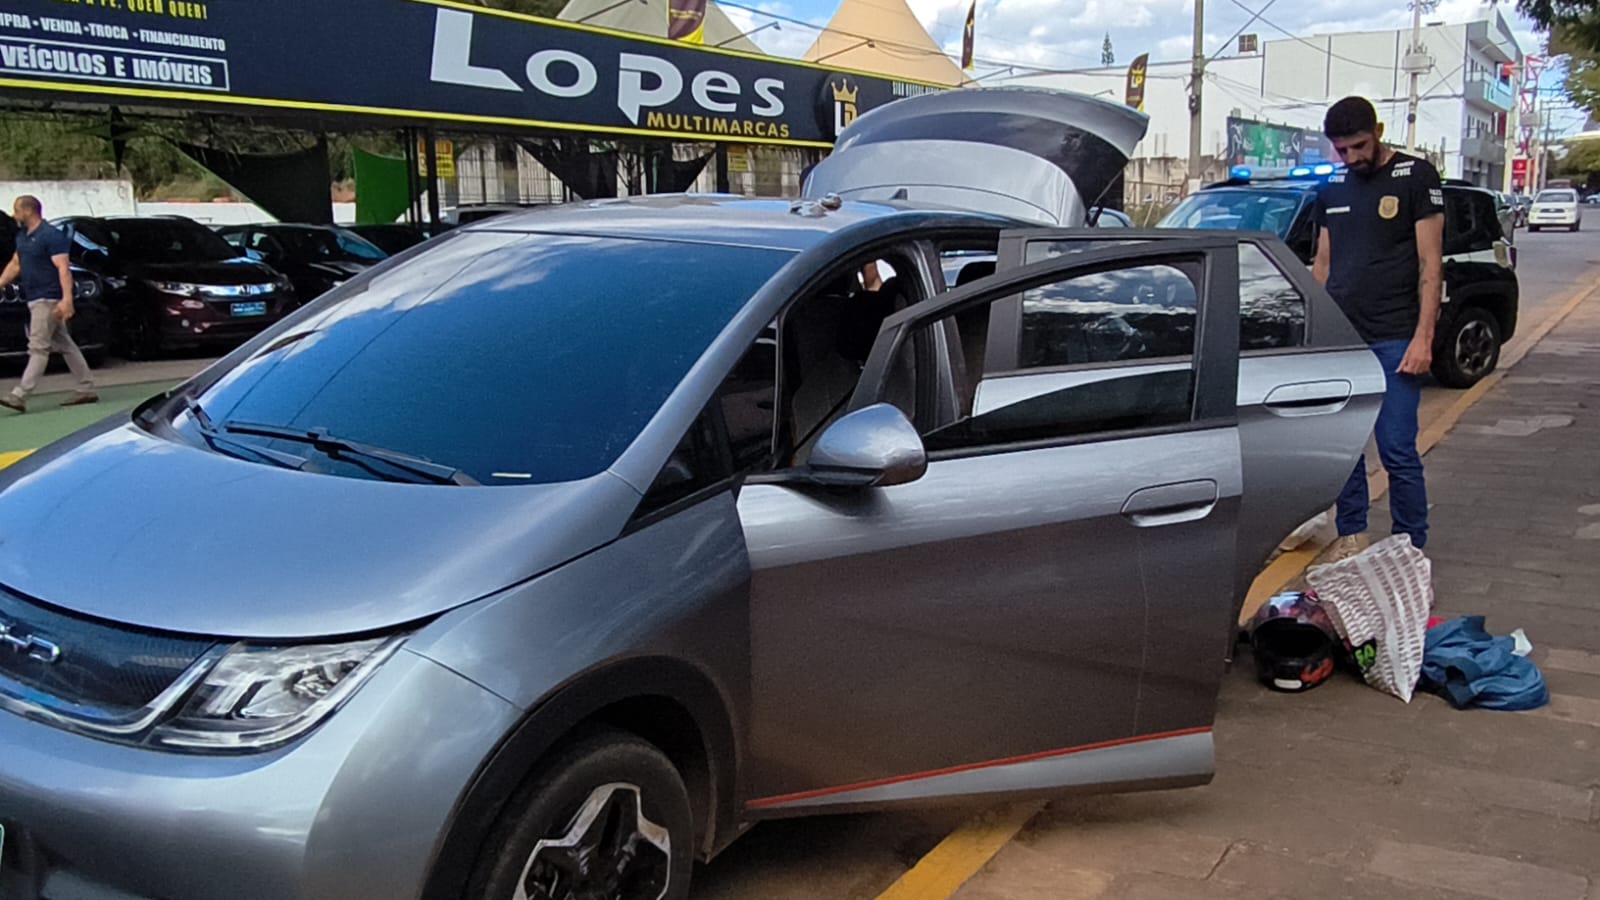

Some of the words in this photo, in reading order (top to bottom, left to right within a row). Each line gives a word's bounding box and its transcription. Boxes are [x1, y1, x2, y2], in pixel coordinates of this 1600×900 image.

[169, 1, 208, 20] QUER!
[40, 17, 82, 35] VENDA
[88, 23, 129, 40] TROCA
[140, 29, 225, 51] FINANCIAMENTO
[1, 45, 107, 75] VEÍCULOS
[114, 57, 126, 77] E
[132, 58, 213, 85] IMÓVEIS
[647, 111, 790, 137] MULTIMARCAS
